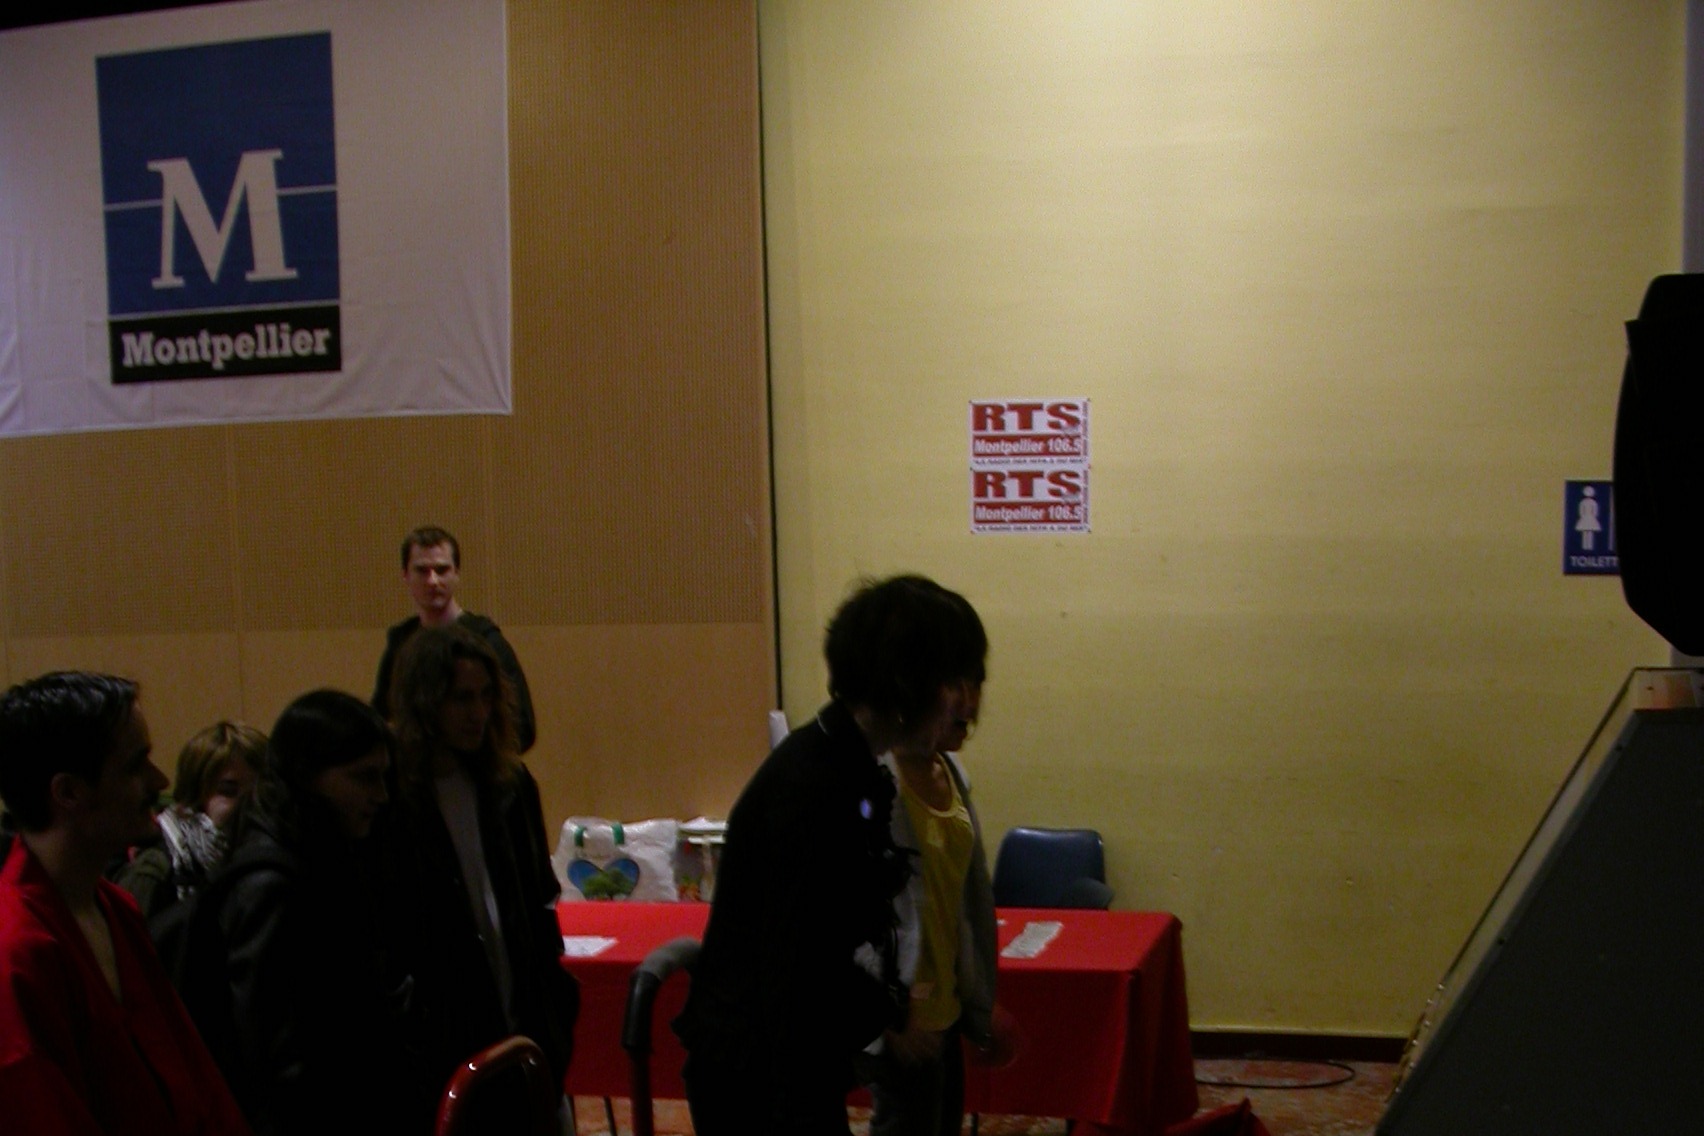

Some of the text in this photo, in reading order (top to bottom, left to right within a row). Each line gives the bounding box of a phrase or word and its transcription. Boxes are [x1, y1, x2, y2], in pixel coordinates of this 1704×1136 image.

[147, 149, 297, 289] M
[122, 322, 330, 370] Montpellier
[974, 403, 1080, 430] RTS
[975, 438, 1045, 455] Montpellier
[974, 471, 1080, 497] RTS
[976, 505, 1046, 522] Montpellier
